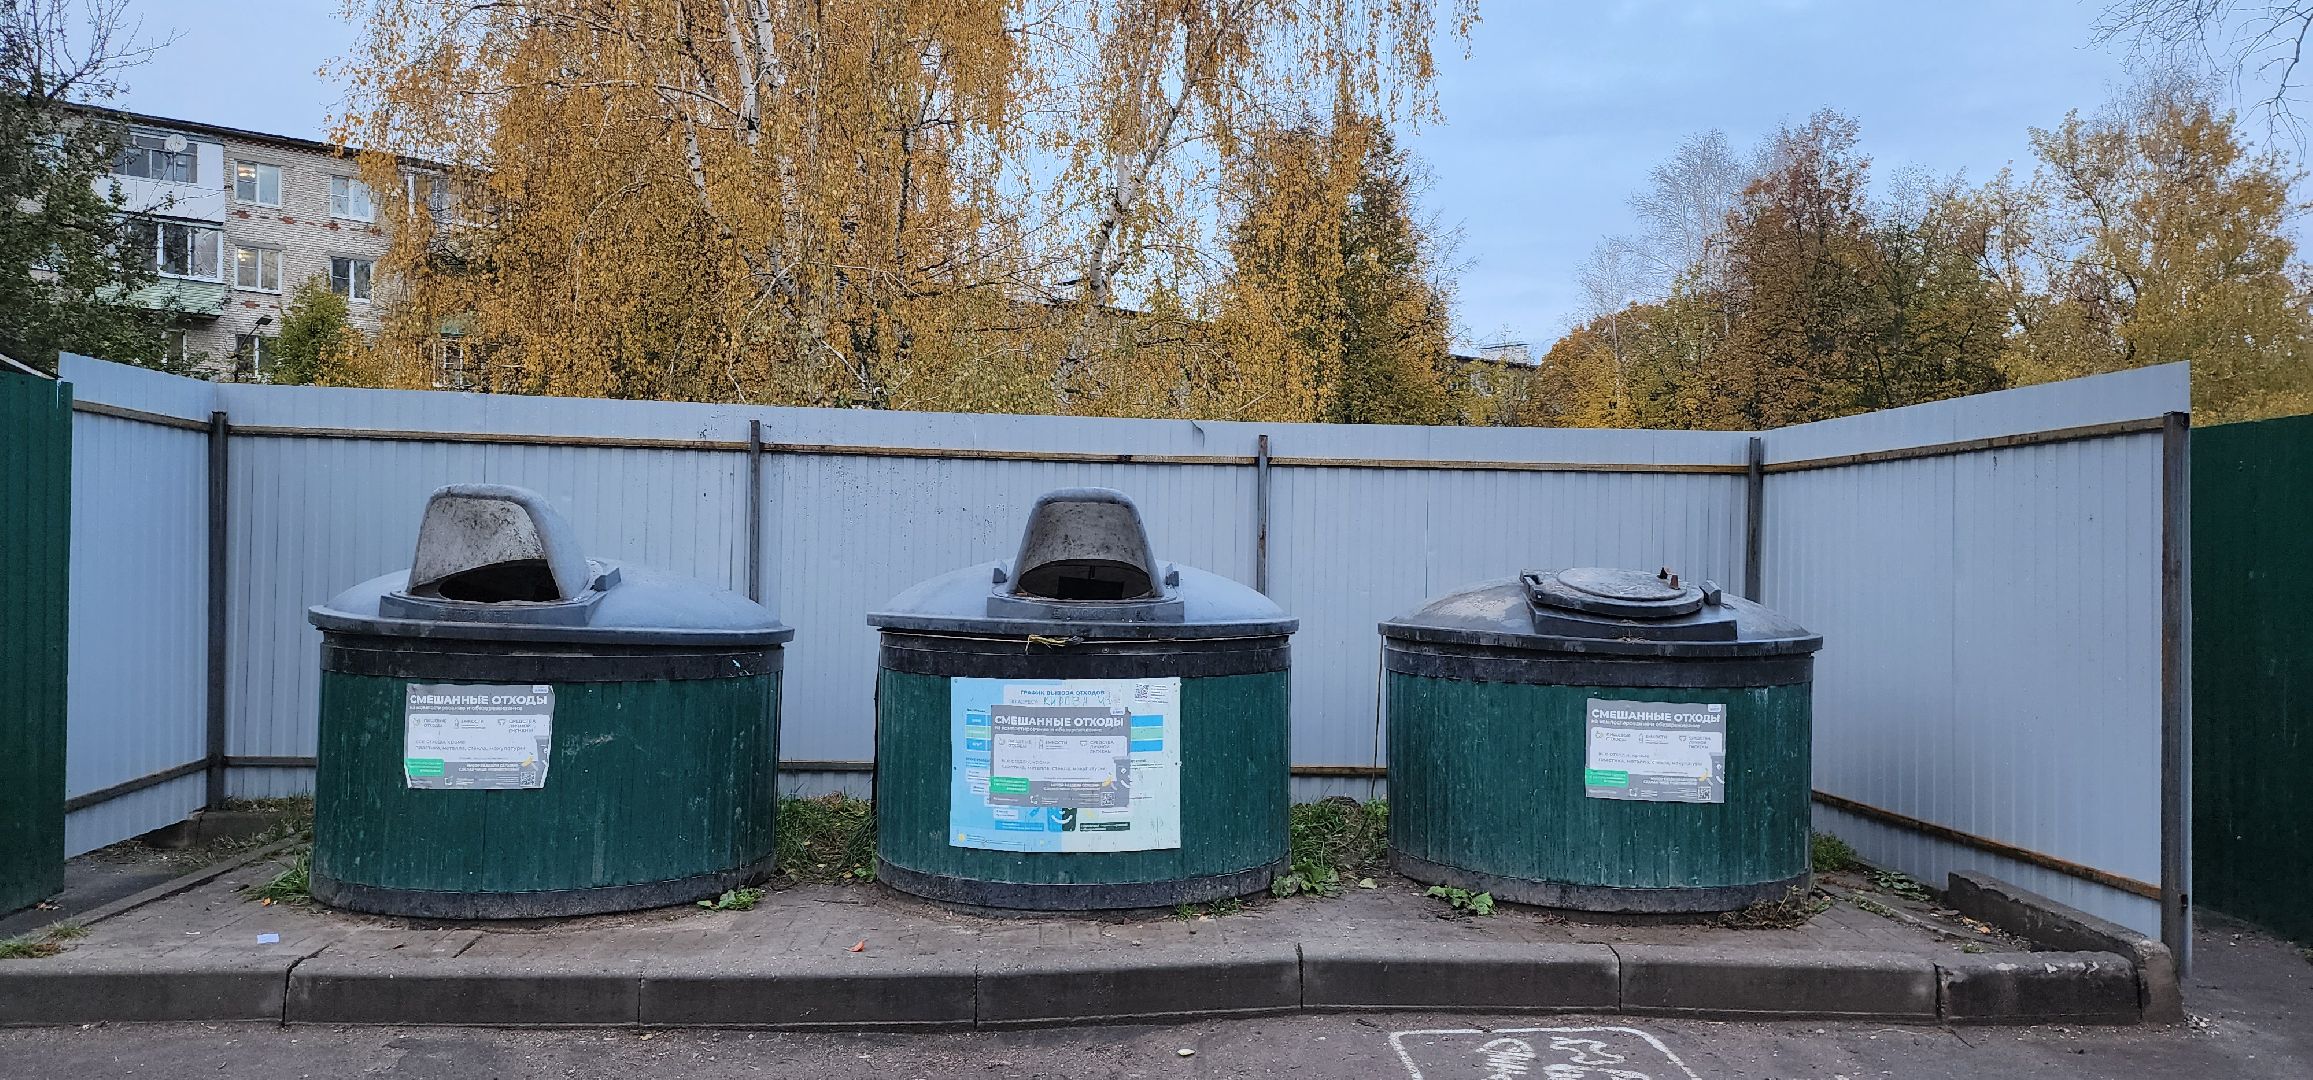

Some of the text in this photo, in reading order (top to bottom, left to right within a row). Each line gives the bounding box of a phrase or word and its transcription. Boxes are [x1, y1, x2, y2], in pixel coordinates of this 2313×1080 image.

[410, 694, 548, 706] СМЕШАННЫЕ ОТХОДЫ
[994, 715, 1124, 728] СМЕШАННЫЕ ОТХОДЫ
[1591, 708, 1721, 724] СМЕШАННЫЕ ОТХОДЫ
